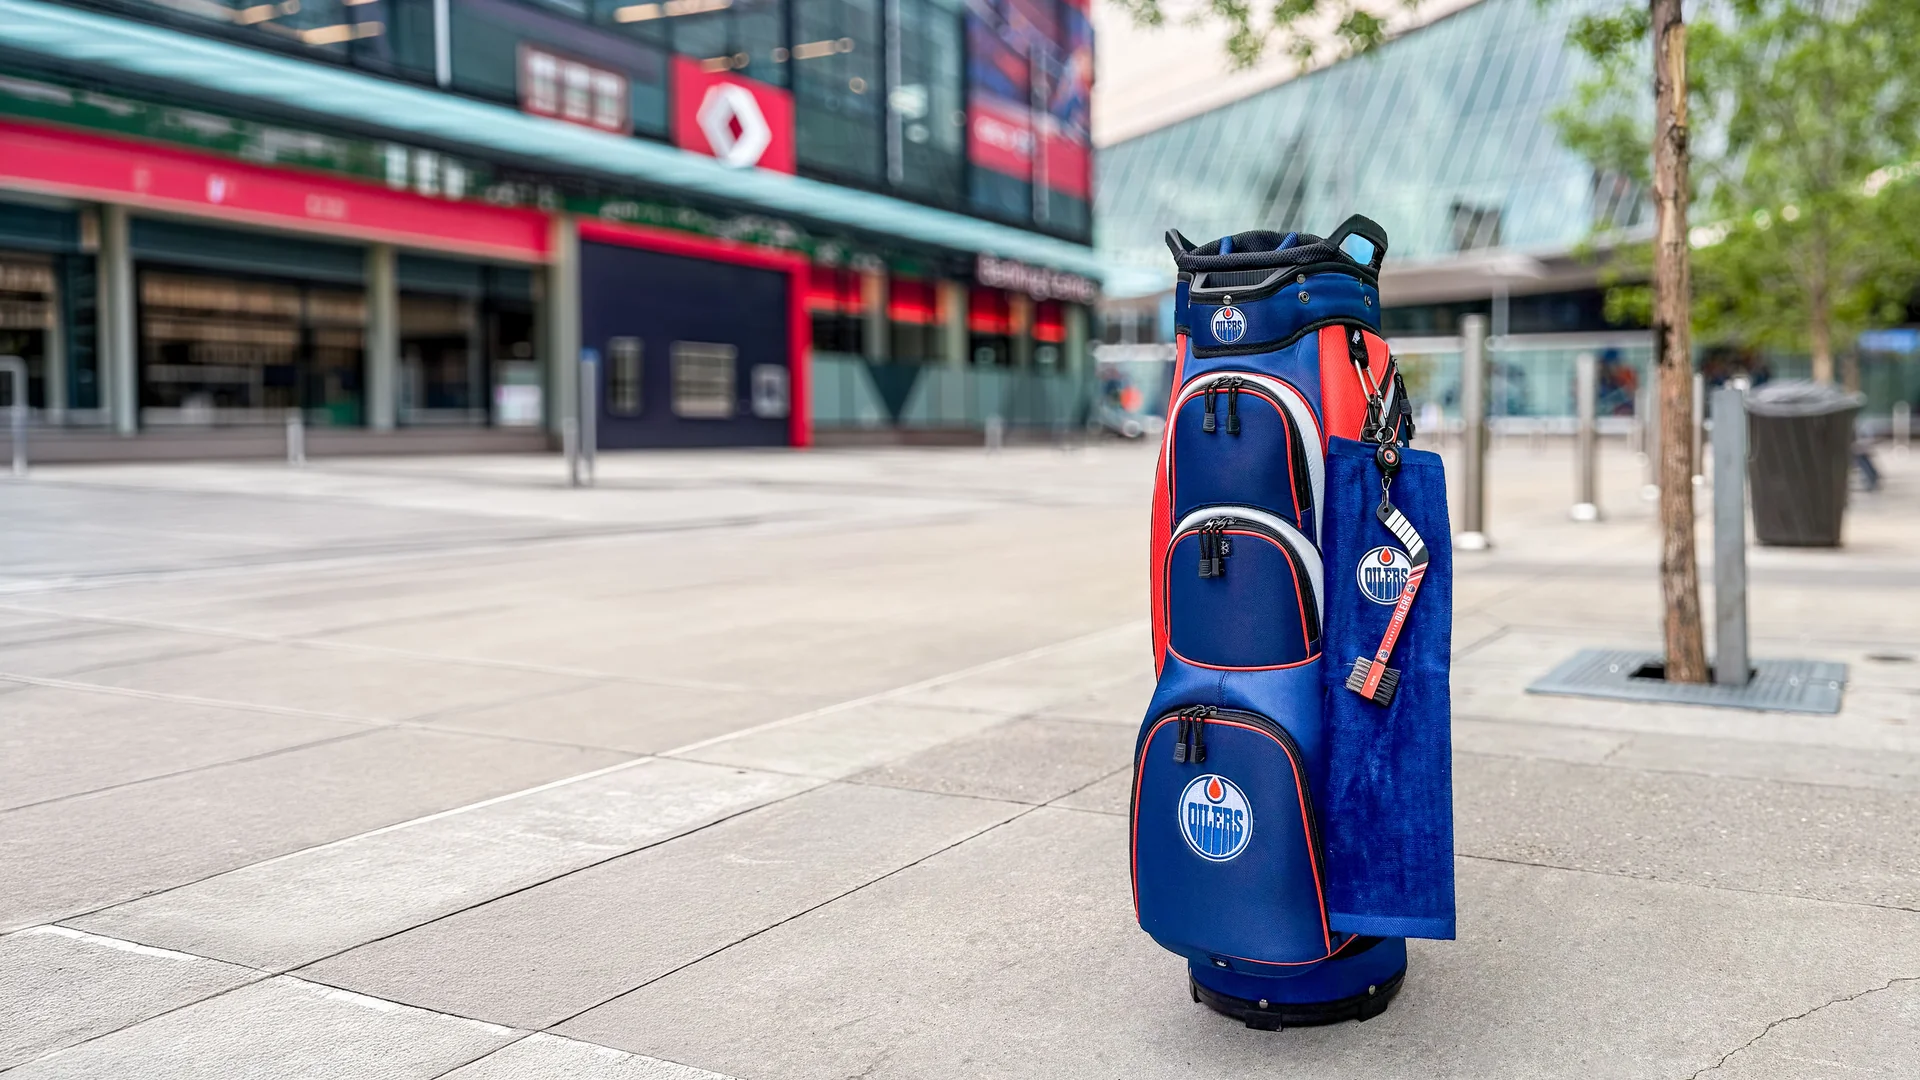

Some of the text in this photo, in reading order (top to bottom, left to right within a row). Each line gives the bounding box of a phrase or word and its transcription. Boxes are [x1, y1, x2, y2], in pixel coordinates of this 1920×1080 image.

[1215, 320, 1243, 341] OILERS
[1364, 567, 1408, 600] OILERS
[1395, 594, 1412, 622] OILERS
[1188, 802, 1244, 856] OILERS
